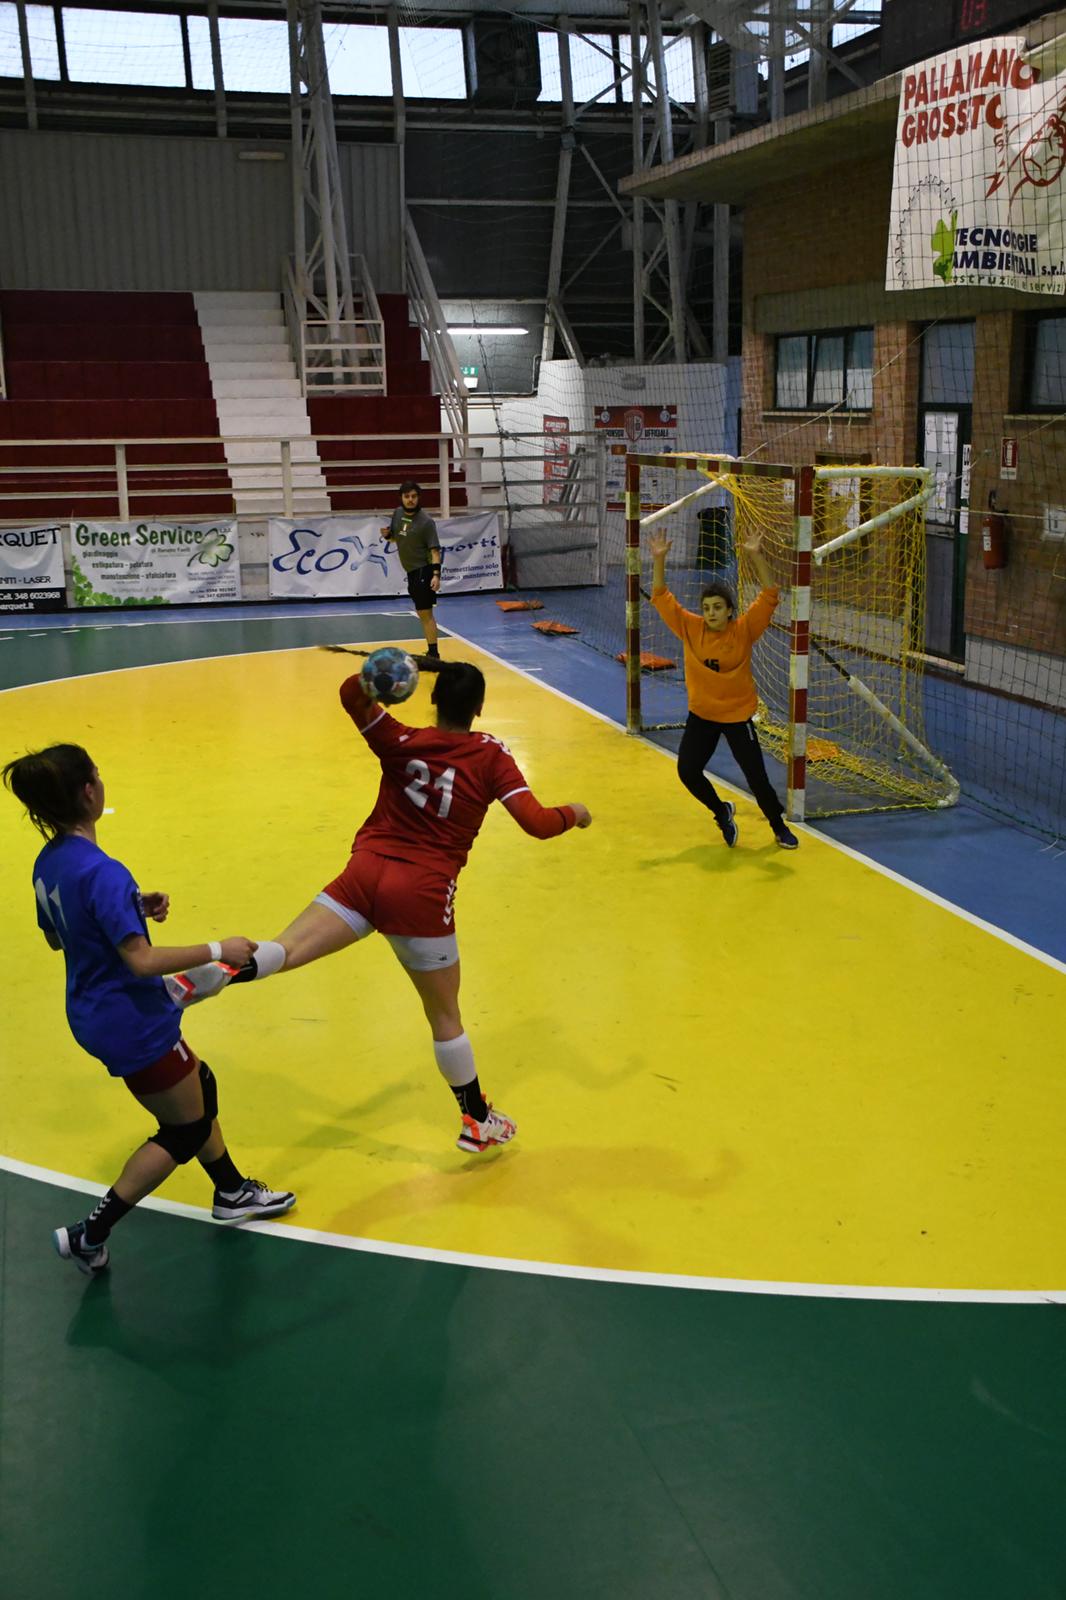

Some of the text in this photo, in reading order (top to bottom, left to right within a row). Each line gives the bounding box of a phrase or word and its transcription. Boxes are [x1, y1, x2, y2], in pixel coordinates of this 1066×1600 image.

[0, 527, 61, 547] QUET
[76, 524, 204, 547] Green Service
[272, 529, 349, 575] Eco
[442, 562, 499, 574] Promettiamo solo
[23, 575, 51, 584] LASER
[14, 592, 29, 600] 348
[404, 759, 456, 819] 21
